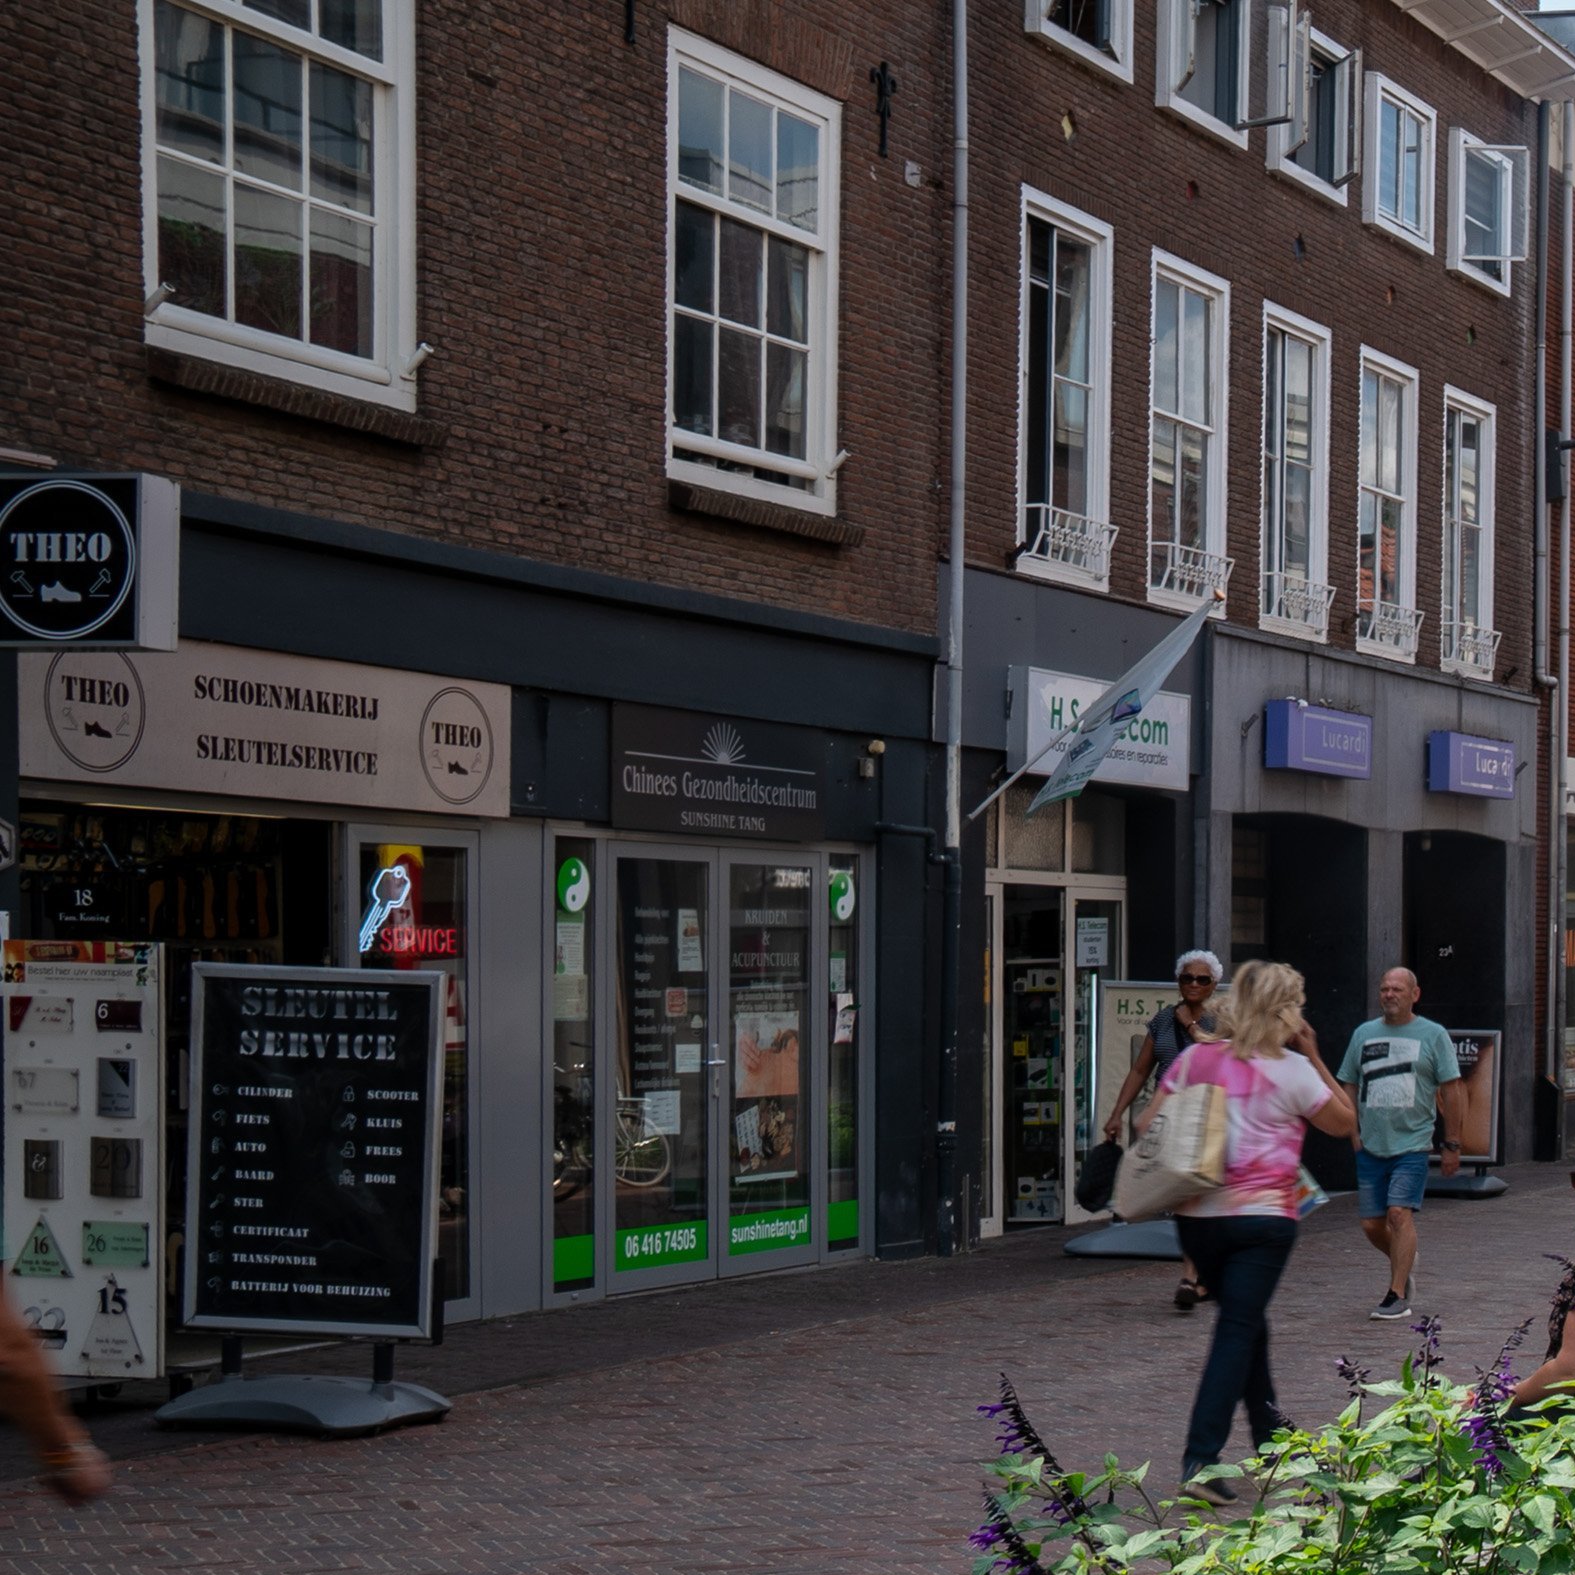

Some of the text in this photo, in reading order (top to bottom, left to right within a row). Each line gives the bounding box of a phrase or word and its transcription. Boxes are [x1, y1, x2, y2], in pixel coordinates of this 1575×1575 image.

[10, 531, 113, 563] THEO
[61, 675, 129, 708] THEO
[194, 674, 380, 721] SCHOENMAKERIJ
[431, 721, 482, 749] THEO
[1322, 726, 1367, 755] Lucardi
[196, 734, 379, 776] SLEUTELSERVICE
[1476, 752, 1513, 777] Lucadi
[623, 765, 817, 810] Chinees Gezondheidscentrum
[681, 811, 766, 832] SUNSHINE TANG
[73, 888, 94, 907] 18
[745, 910, 788, 925] KRUIDEN
[380, 928, 457, 954] SERVICE
[732, 952, 800, 967] ACUPUNCTUUR
[240, 986, 398, 1021] SLEUTEL
[239, 1029, 397, 1062] SERVICE
[237, 1086, 294, 1099] CILINDER
[366, 1088, 420, 1102] SCOOTER
[235, 1113, 271, 1126] FIETS
[366, 1117, 403, 1129] KLUIS
[234, 1141, 267, 1153] AUTO
[365, 1145, 403, 1158] FREES
[235, 1169, 274, 1182] BAARD
[364, 1173, 397, 1185] BOOR
[233, 1196, 264, 1209] STER
[232, 1224, 310, 1239] CERTIFICAAT
[731, 1213, 809, 1244] sunshinetang.nl
[33, 1236, 49, 1255] 16
[87, 1233, 106, 1253] 26
[625, 1227, 697, 1259] 06 416 74505
[231, 1252, 318, 1267] TRANSPONDER
[231, 1280, 392, 1298] BATTERIJ VOOR BEHUIZING
[98, 1287, 129, 1315] 15
